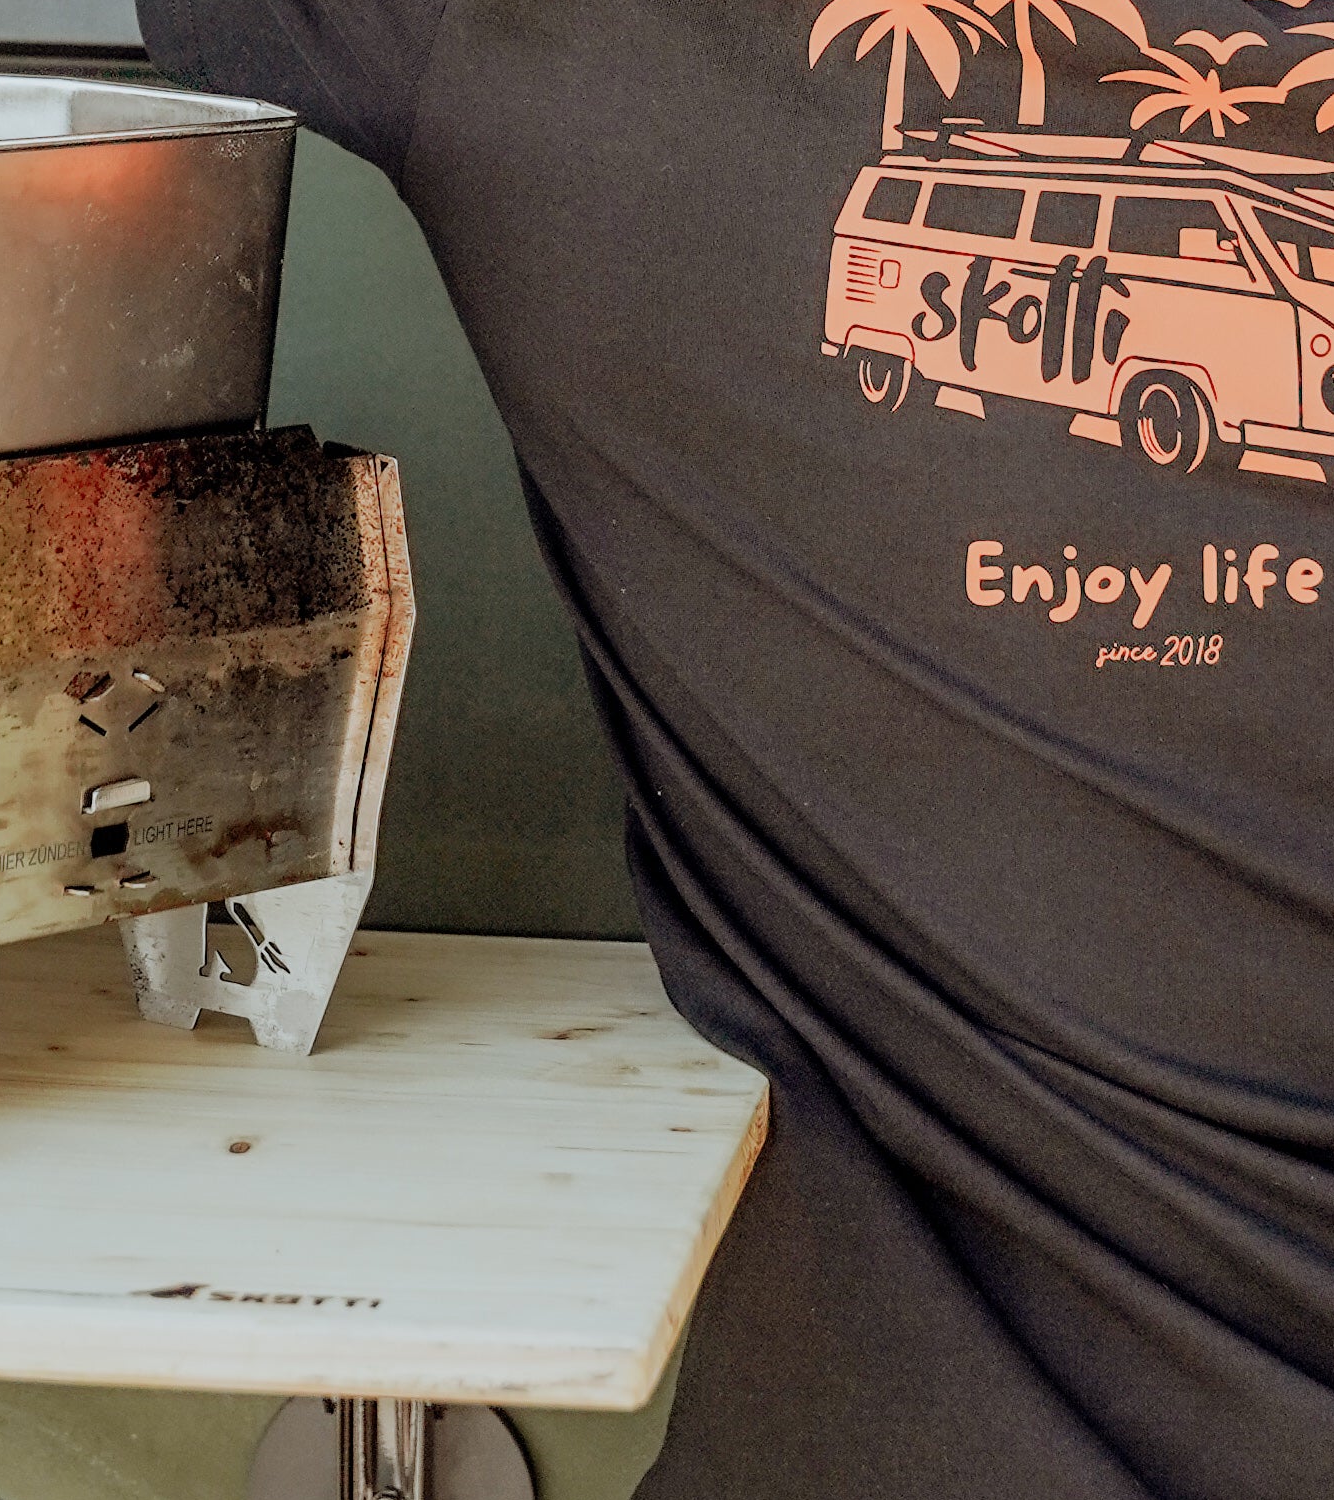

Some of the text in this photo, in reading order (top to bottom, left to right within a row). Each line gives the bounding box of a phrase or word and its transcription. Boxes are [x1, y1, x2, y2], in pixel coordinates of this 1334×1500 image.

[964, 539, 1325, 630] Enjoy life
[1094, 634, 1224, 669] since 2018
[133, 815, 214, 846] LIGHT HERE
[28, 840, 85, 867] ZÜNDEN
[207, 1290, 384, 1310] SKOTTI
